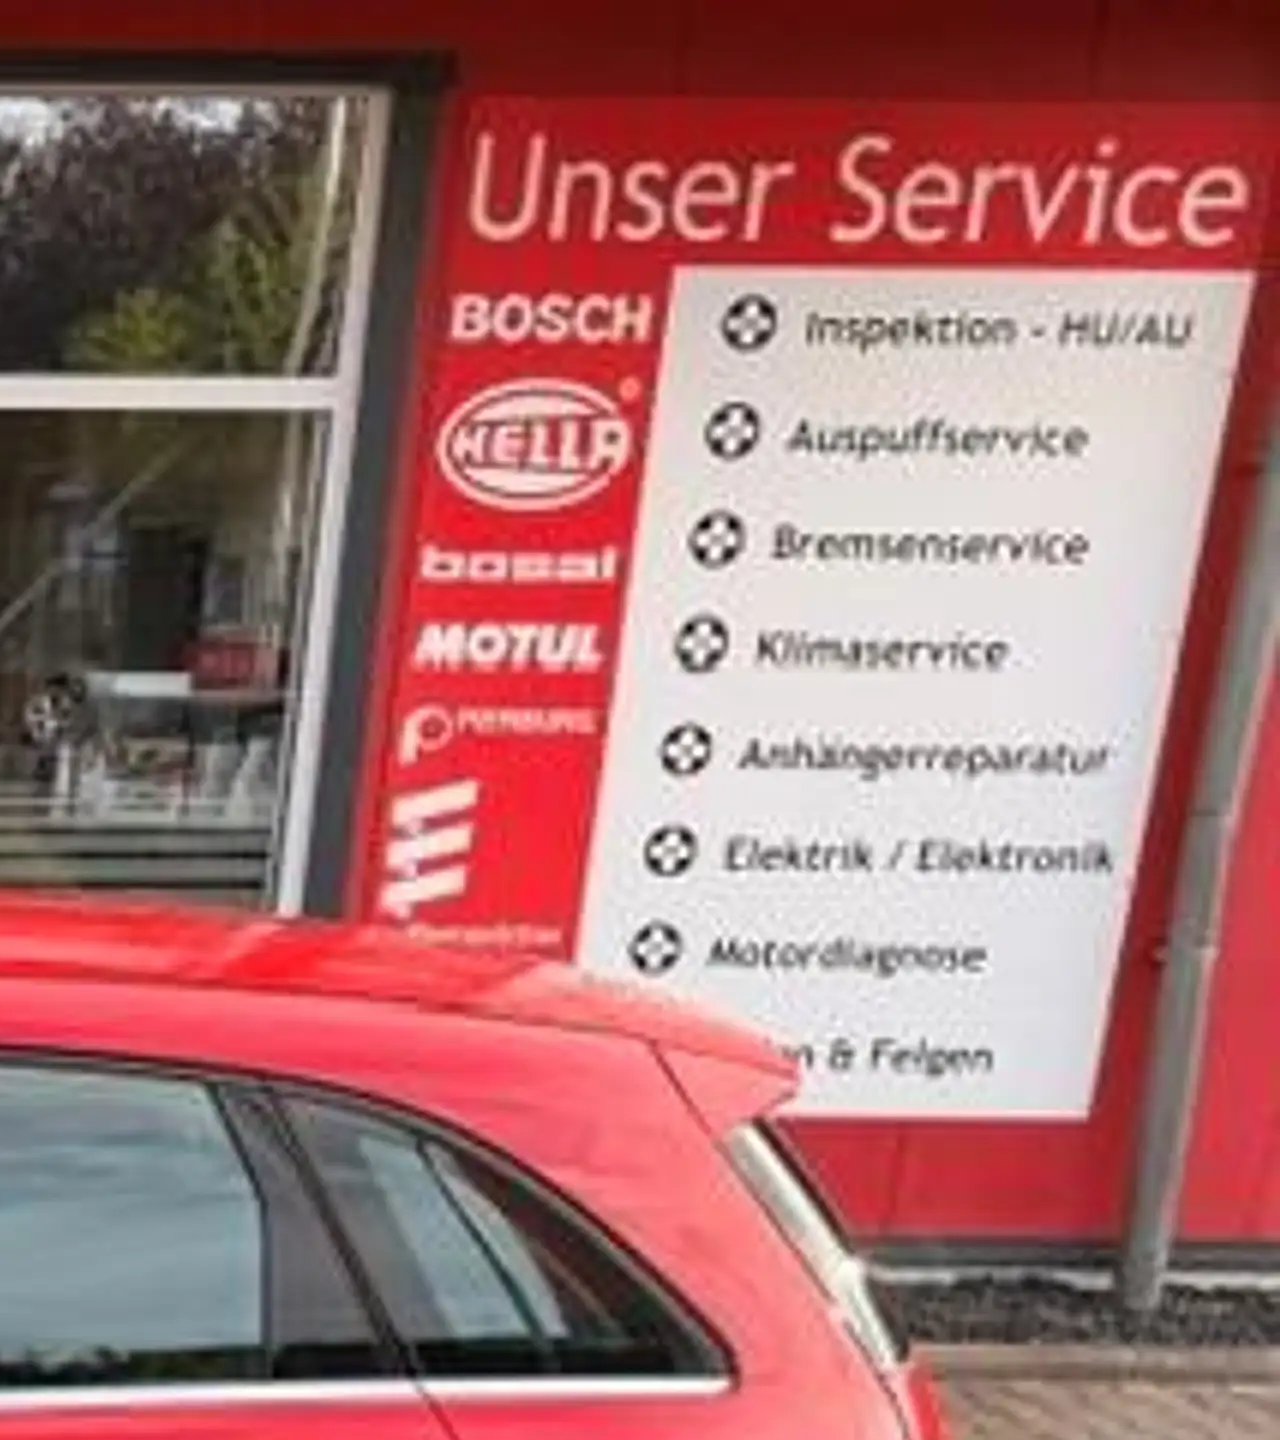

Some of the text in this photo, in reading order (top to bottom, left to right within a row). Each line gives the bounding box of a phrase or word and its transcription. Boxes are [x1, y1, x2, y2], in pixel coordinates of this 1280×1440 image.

[469, 132, 1250, 248] Unser Service
[450, 293, 653, 343] BOSCH
[804, 309, 1018, 352] Inspektion
[1058, 311, 1193, 347] HU/AU
[450, 418, 632, 474] HELLA
[787, 420, 1090, 459] Auspuffservice
[418, 544, 619, 584] bosal
[771, 524, 1090, 565] Bremsenservice
[412, 621, 604, 672] MOTUL
[755, 633, 1009, 669] Klimaservice
[738, 739, 1109, 780] Anhängerreparatur
[724, 839, 873, 873] Elektrik
[917, 839, 1114, 874] Elektronik
[705, 937, 988, 976] Motordiagnose
[828, 1036, 856, 1072] &
[870, 1036, 995, 1078] Felgen
